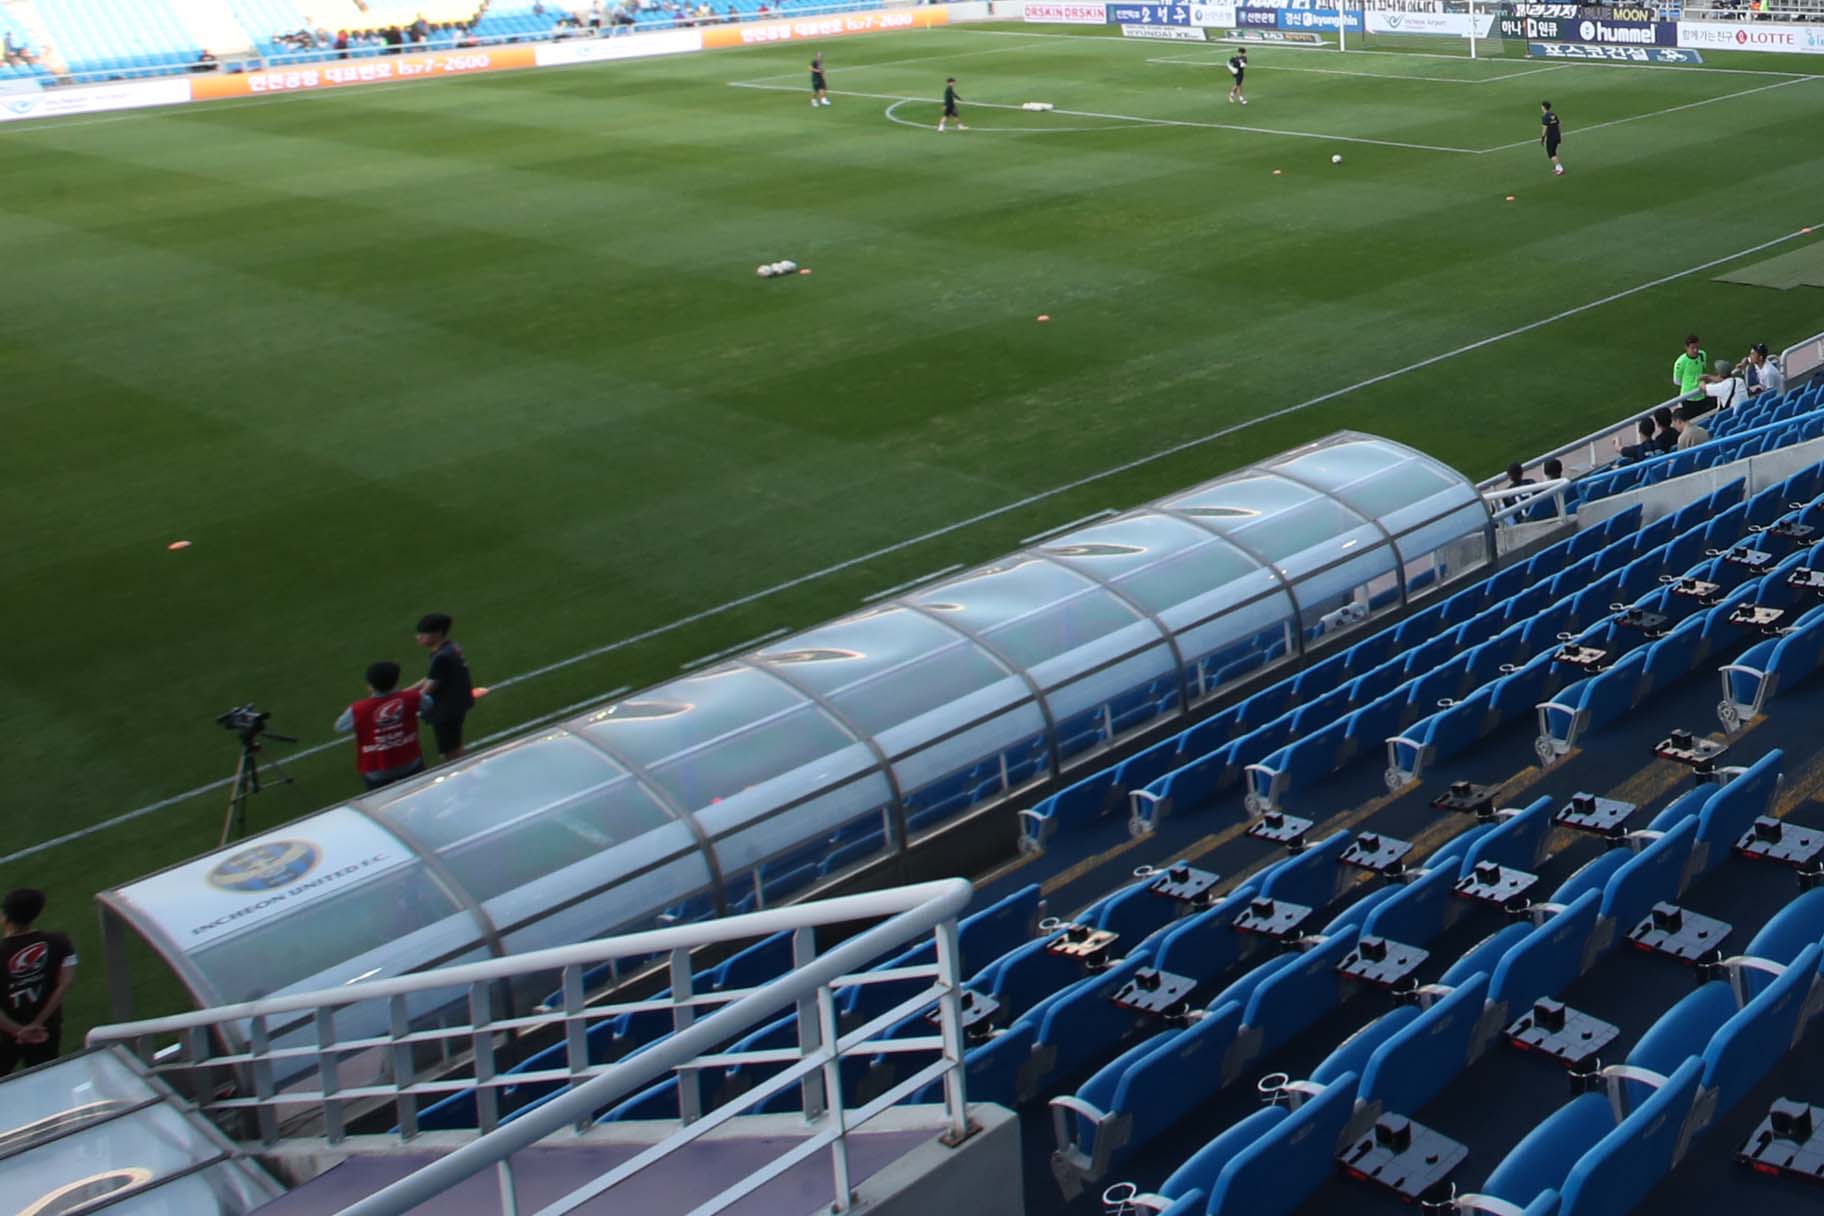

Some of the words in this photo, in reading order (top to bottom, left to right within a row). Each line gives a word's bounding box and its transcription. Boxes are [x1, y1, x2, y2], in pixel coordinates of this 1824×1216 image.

[1247, 12, 1276, 25] 신한은행
[1613, 8, 1649, 21] MOON
[1597, 22, 1657, 44] hummel
[1750, 32, 1795, 45] LOTTE
[1544, 44, 1650, 62] 포스코건설
[193, 894, 286, 935] INCHEON
[288, 865, 359, 896] UNITED
